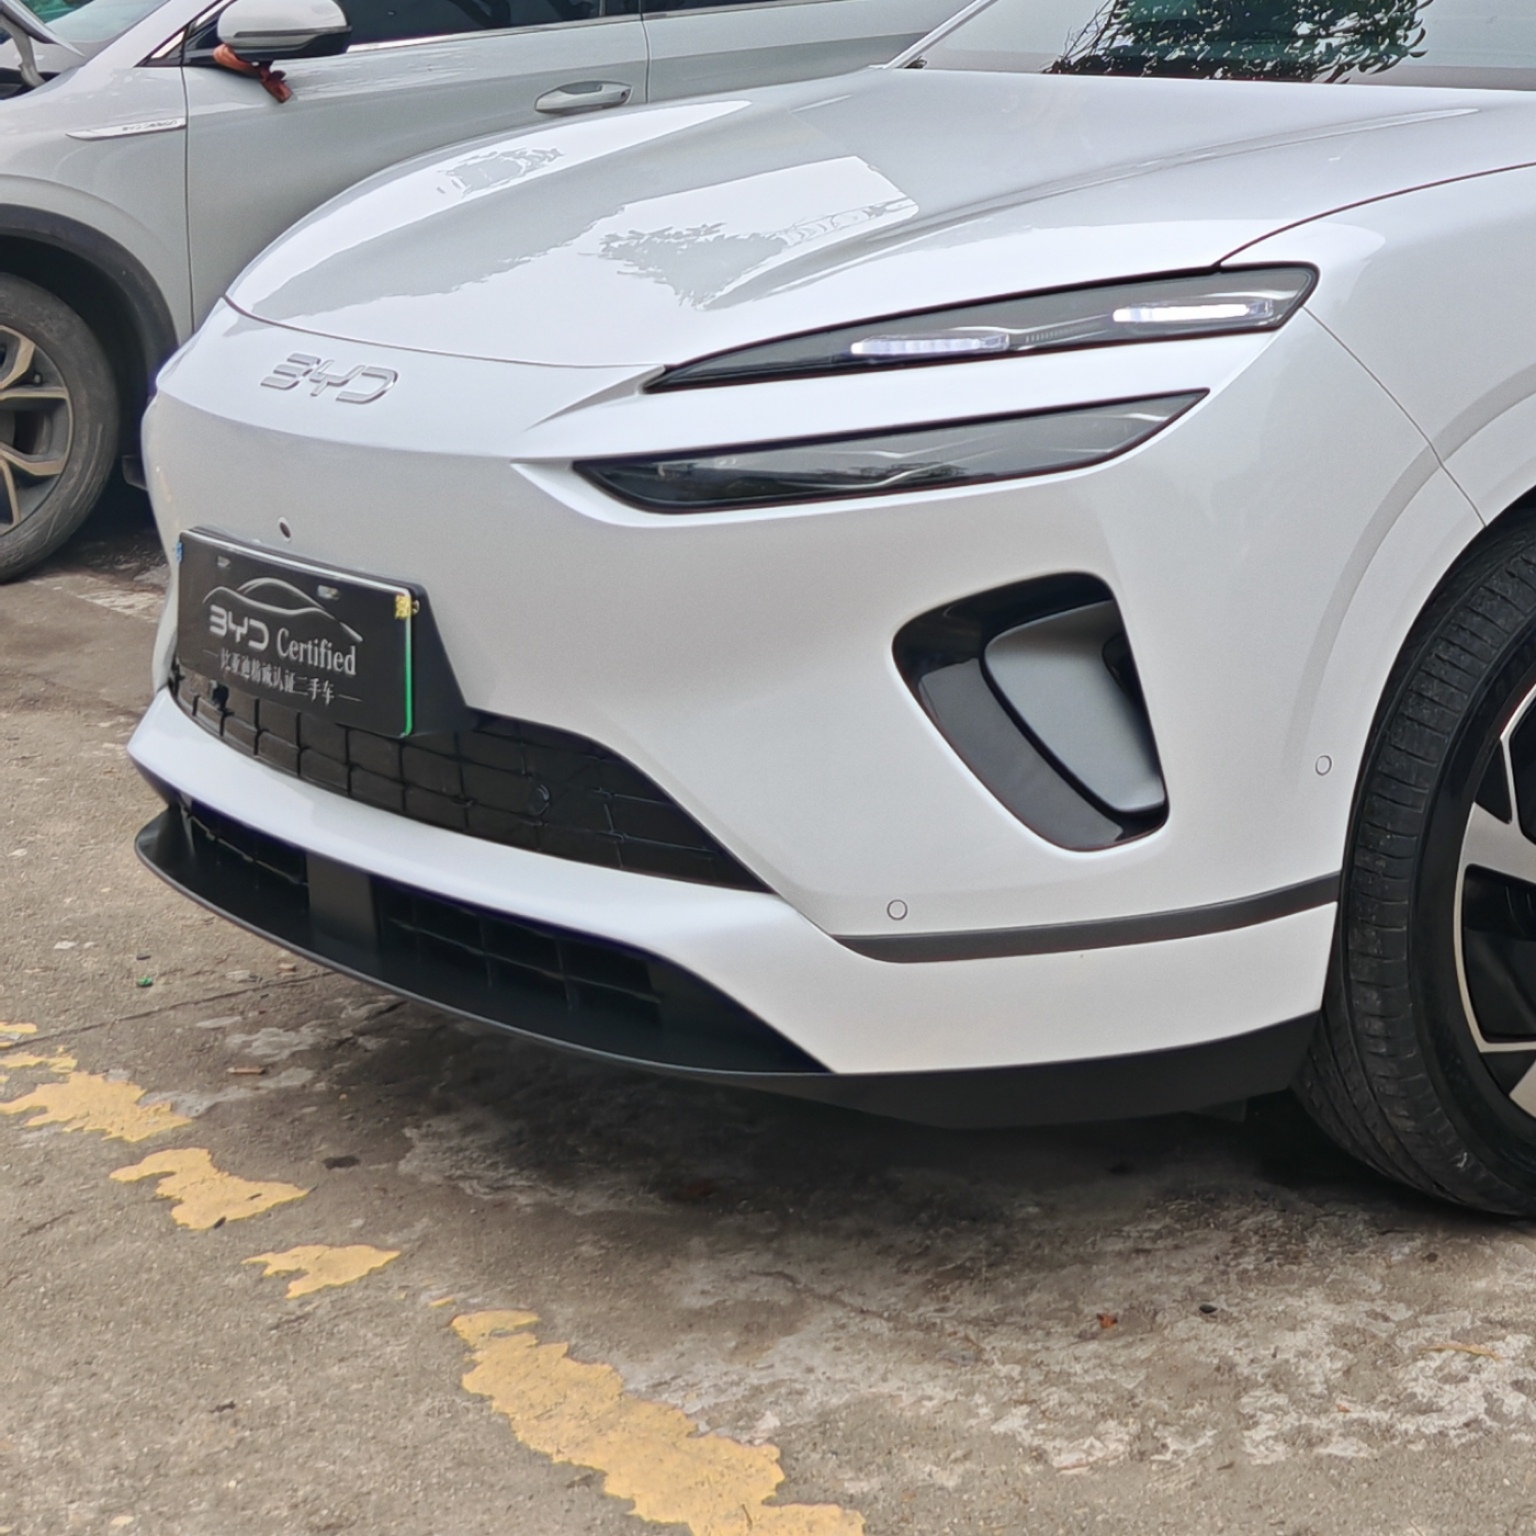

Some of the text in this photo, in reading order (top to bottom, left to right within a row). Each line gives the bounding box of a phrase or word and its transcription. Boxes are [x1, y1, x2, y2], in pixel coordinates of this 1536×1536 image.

[259, 352, 399, 405] BYD
[208, 605, 357, 676] BYD Certified
